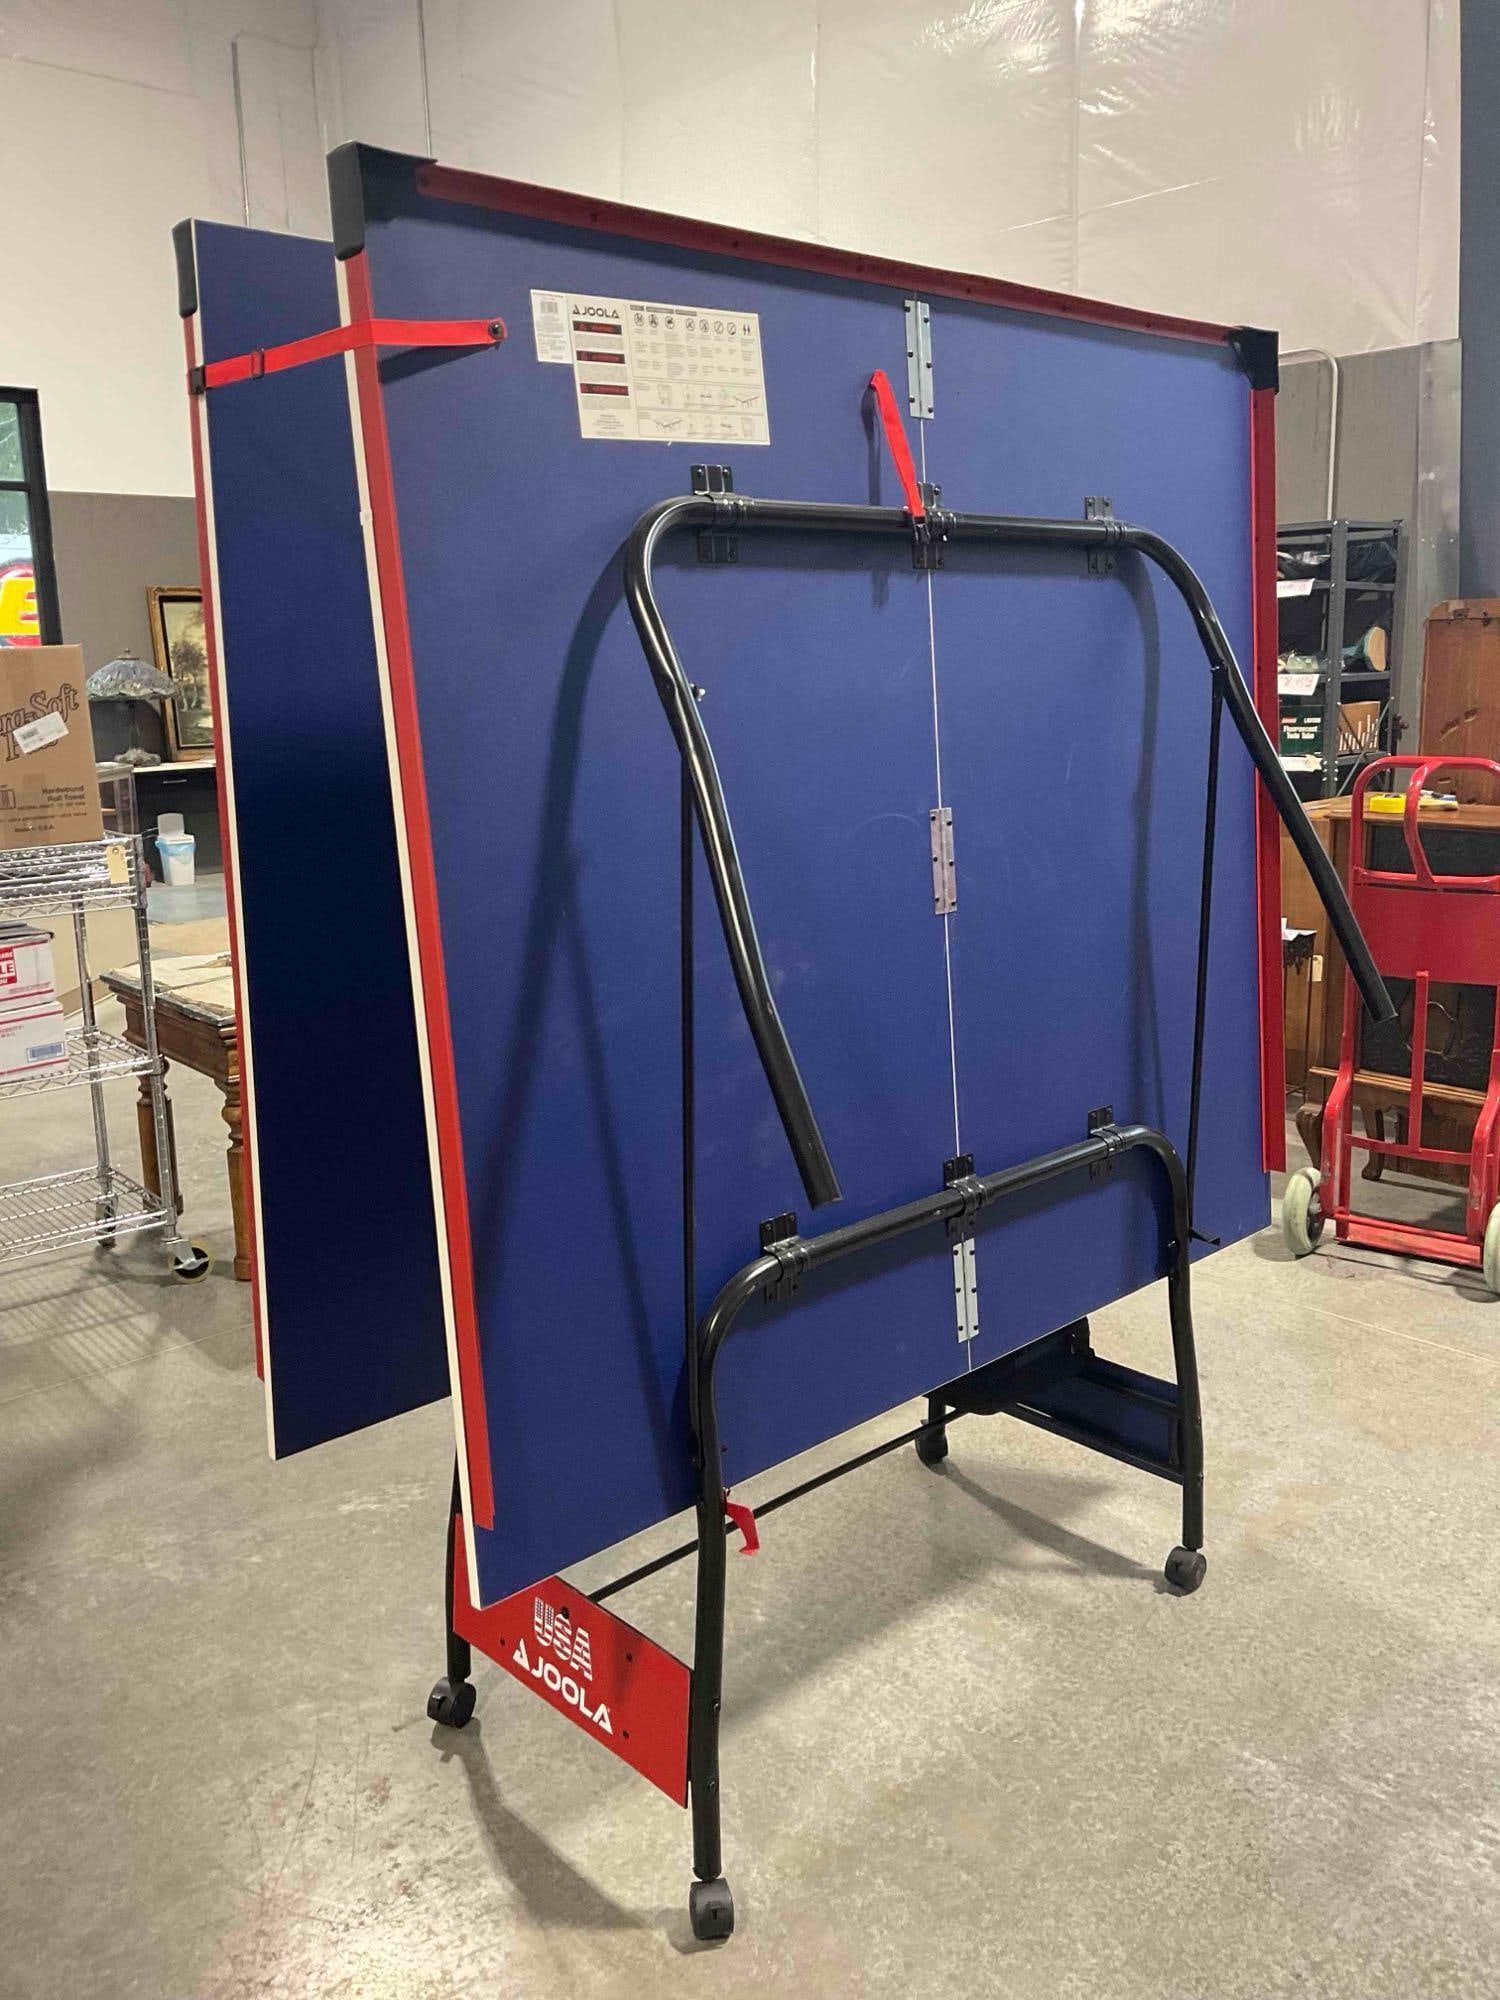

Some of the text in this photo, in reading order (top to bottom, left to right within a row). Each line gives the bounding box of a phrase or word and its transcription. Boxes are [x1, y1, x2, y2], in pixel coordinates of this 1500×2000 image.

[582, 306, 620, 319] JOOLA
[533, 1597, 593, 1682] USA
[530, 1656, 614, 1736] JOOLA
